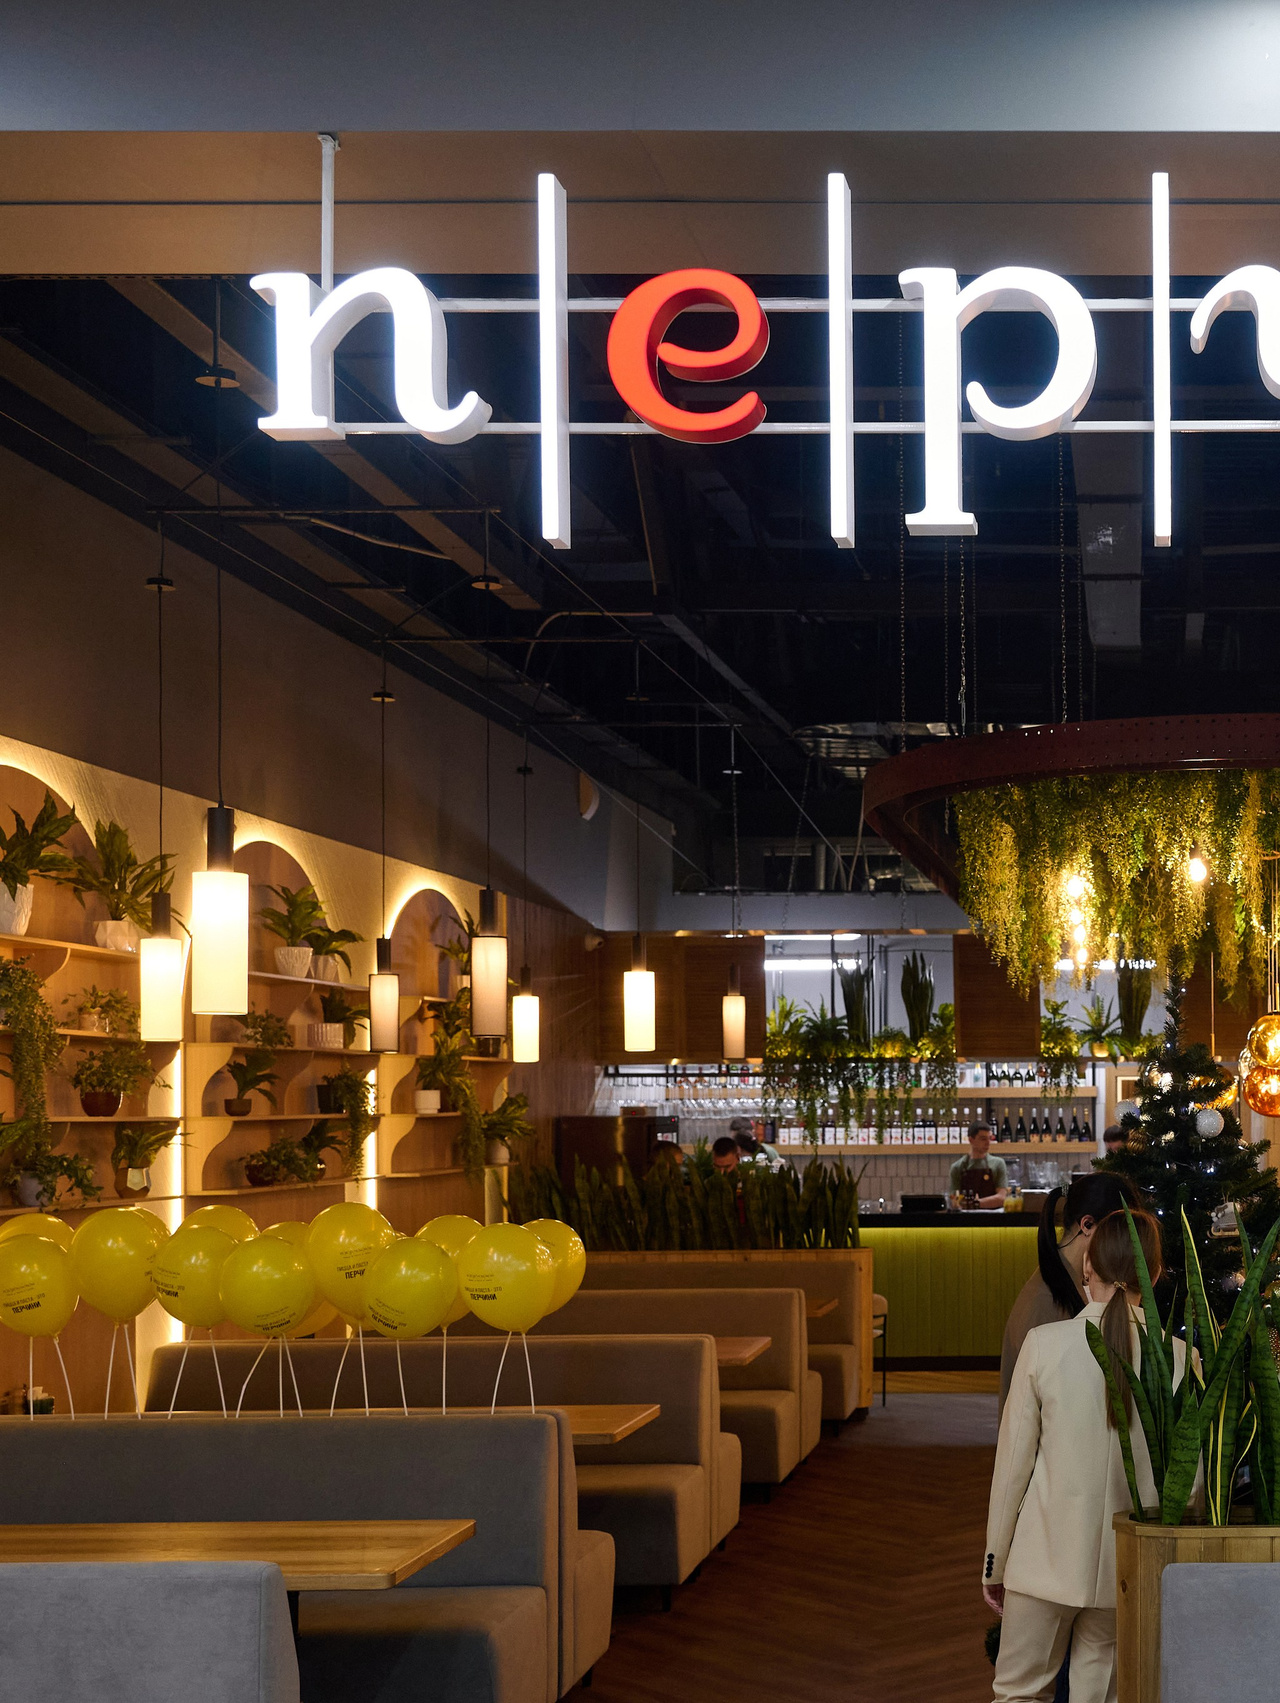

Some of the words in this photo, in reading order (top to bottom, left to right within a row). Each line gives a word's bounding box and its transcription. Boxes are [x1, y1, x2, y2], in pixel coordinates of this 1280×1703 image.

[345, 1268, 366, 1279] ПЕРЧИ
[470, 1293, 498, 1301] ПЕРЧИНИ
[12, 1301, 42, 1314] ПЕРЧИНИ
